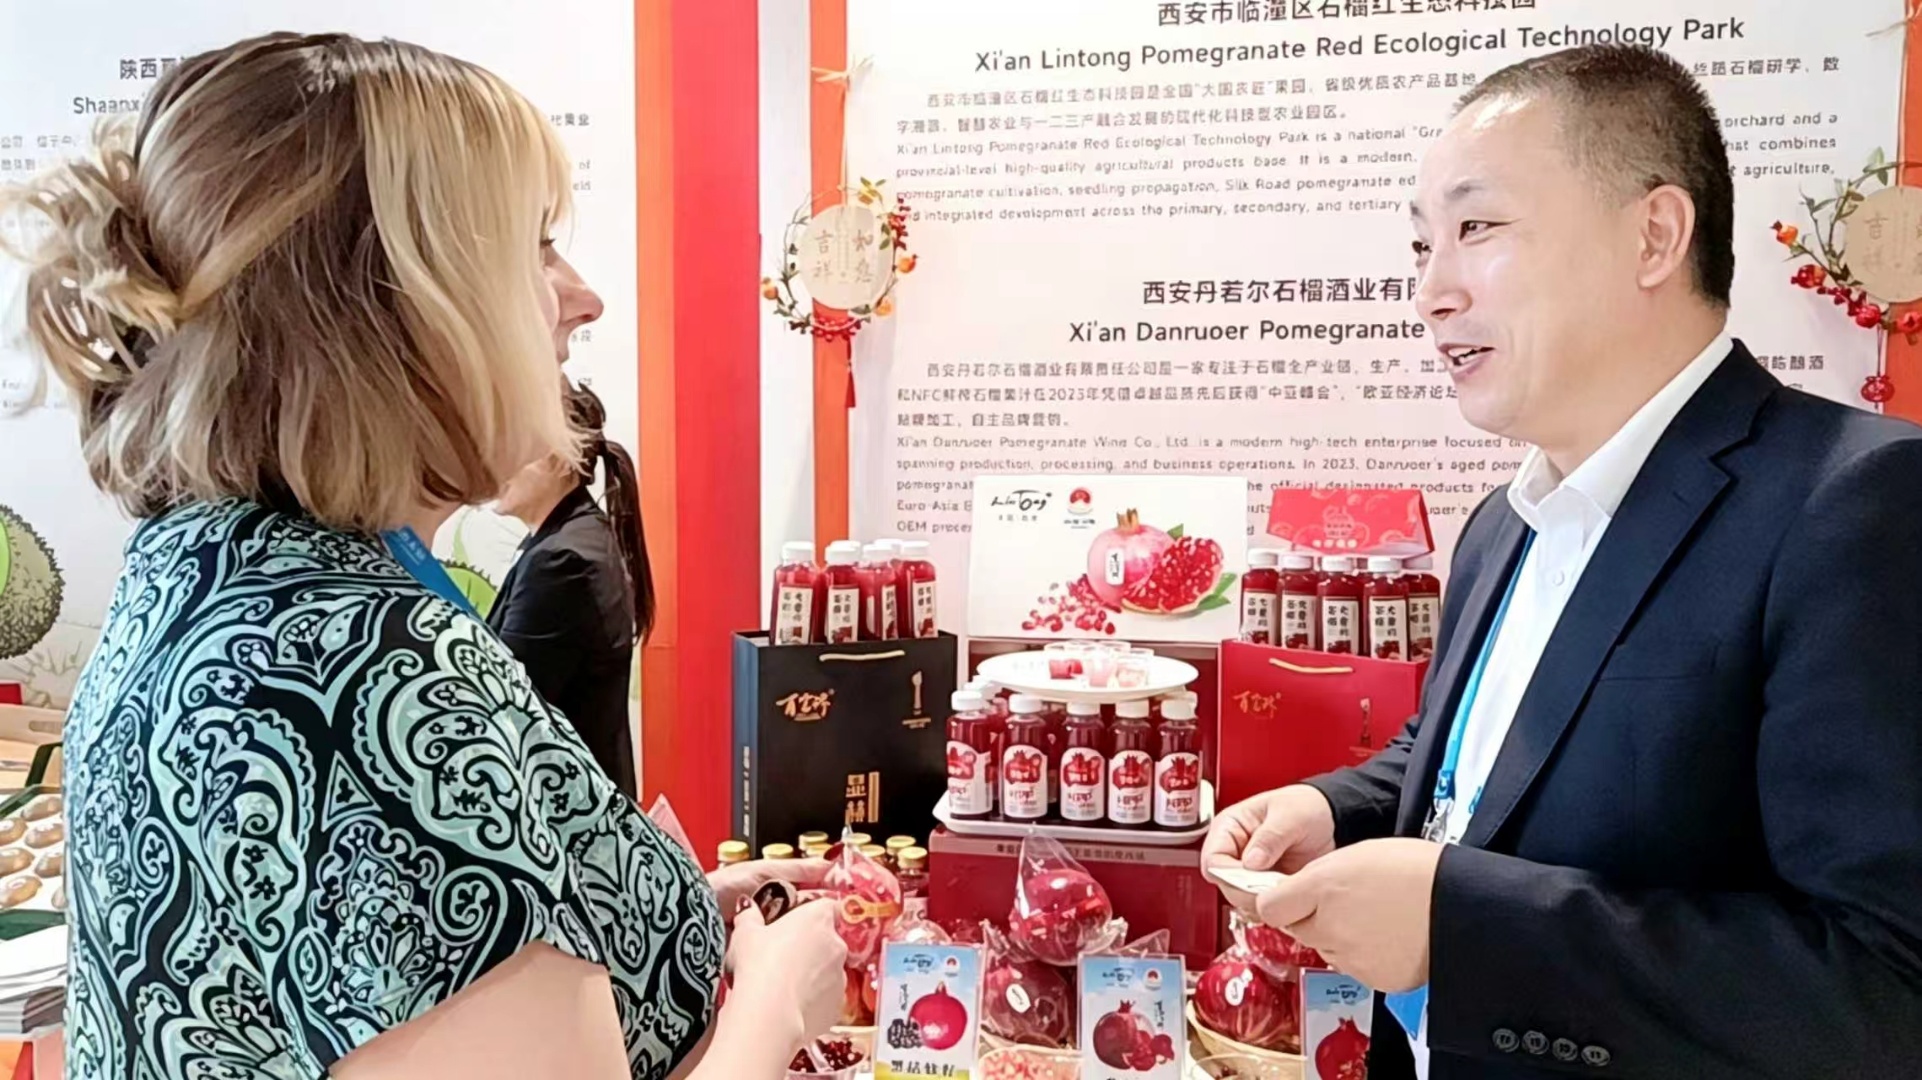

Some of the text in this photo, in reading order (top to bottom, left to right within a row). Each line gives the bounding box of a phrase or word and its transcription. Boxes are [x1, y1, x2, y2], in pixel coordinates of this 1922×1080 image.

[975, 17, 1745, 71] Xi'an Lintong Pomegranate Red Ecological Technology Park
[73, 95, 142, 114] Shaanx
[1724, 112, 1838, 128] orchard and a
[1193, 132, 1271, 148] Technology
[1279, 130, 1309, 143] Park
[1348, 127, 1405, 140] national
[1759, 137, 1837, 150] combines
[1183, 157, 1244, 171] products
[1319, 153, 1330, 164] is
[1340, 154, 1348, 164] a
[1297, 176, 1391, 191] pomegranate
[1141, 204, 1163, 216] the
[1316, 200, 1342, 212] and
[1349, 199, 1402, 213] tertiary
[1069, 319, 1426, 345] Xi'an Danruoer Pomegranate
[999, 436, 1087, 451] Pomegranate
[1216, 438, 1223, 448] a
[1230, 436, 1283, 448] modern
[1364, 436, 1437, 450] enterprise
[1445, 435, 1501, 448] focused
[1123, 458, 1148, 470] and
[1153, 458, 1212, 470] business
[1303, 458, 1316, 470] In
[1450, 459, 1486, 473] aged
[896, 480, 974, 492] pomegranat
[896, 520, 927, 533] OEM
